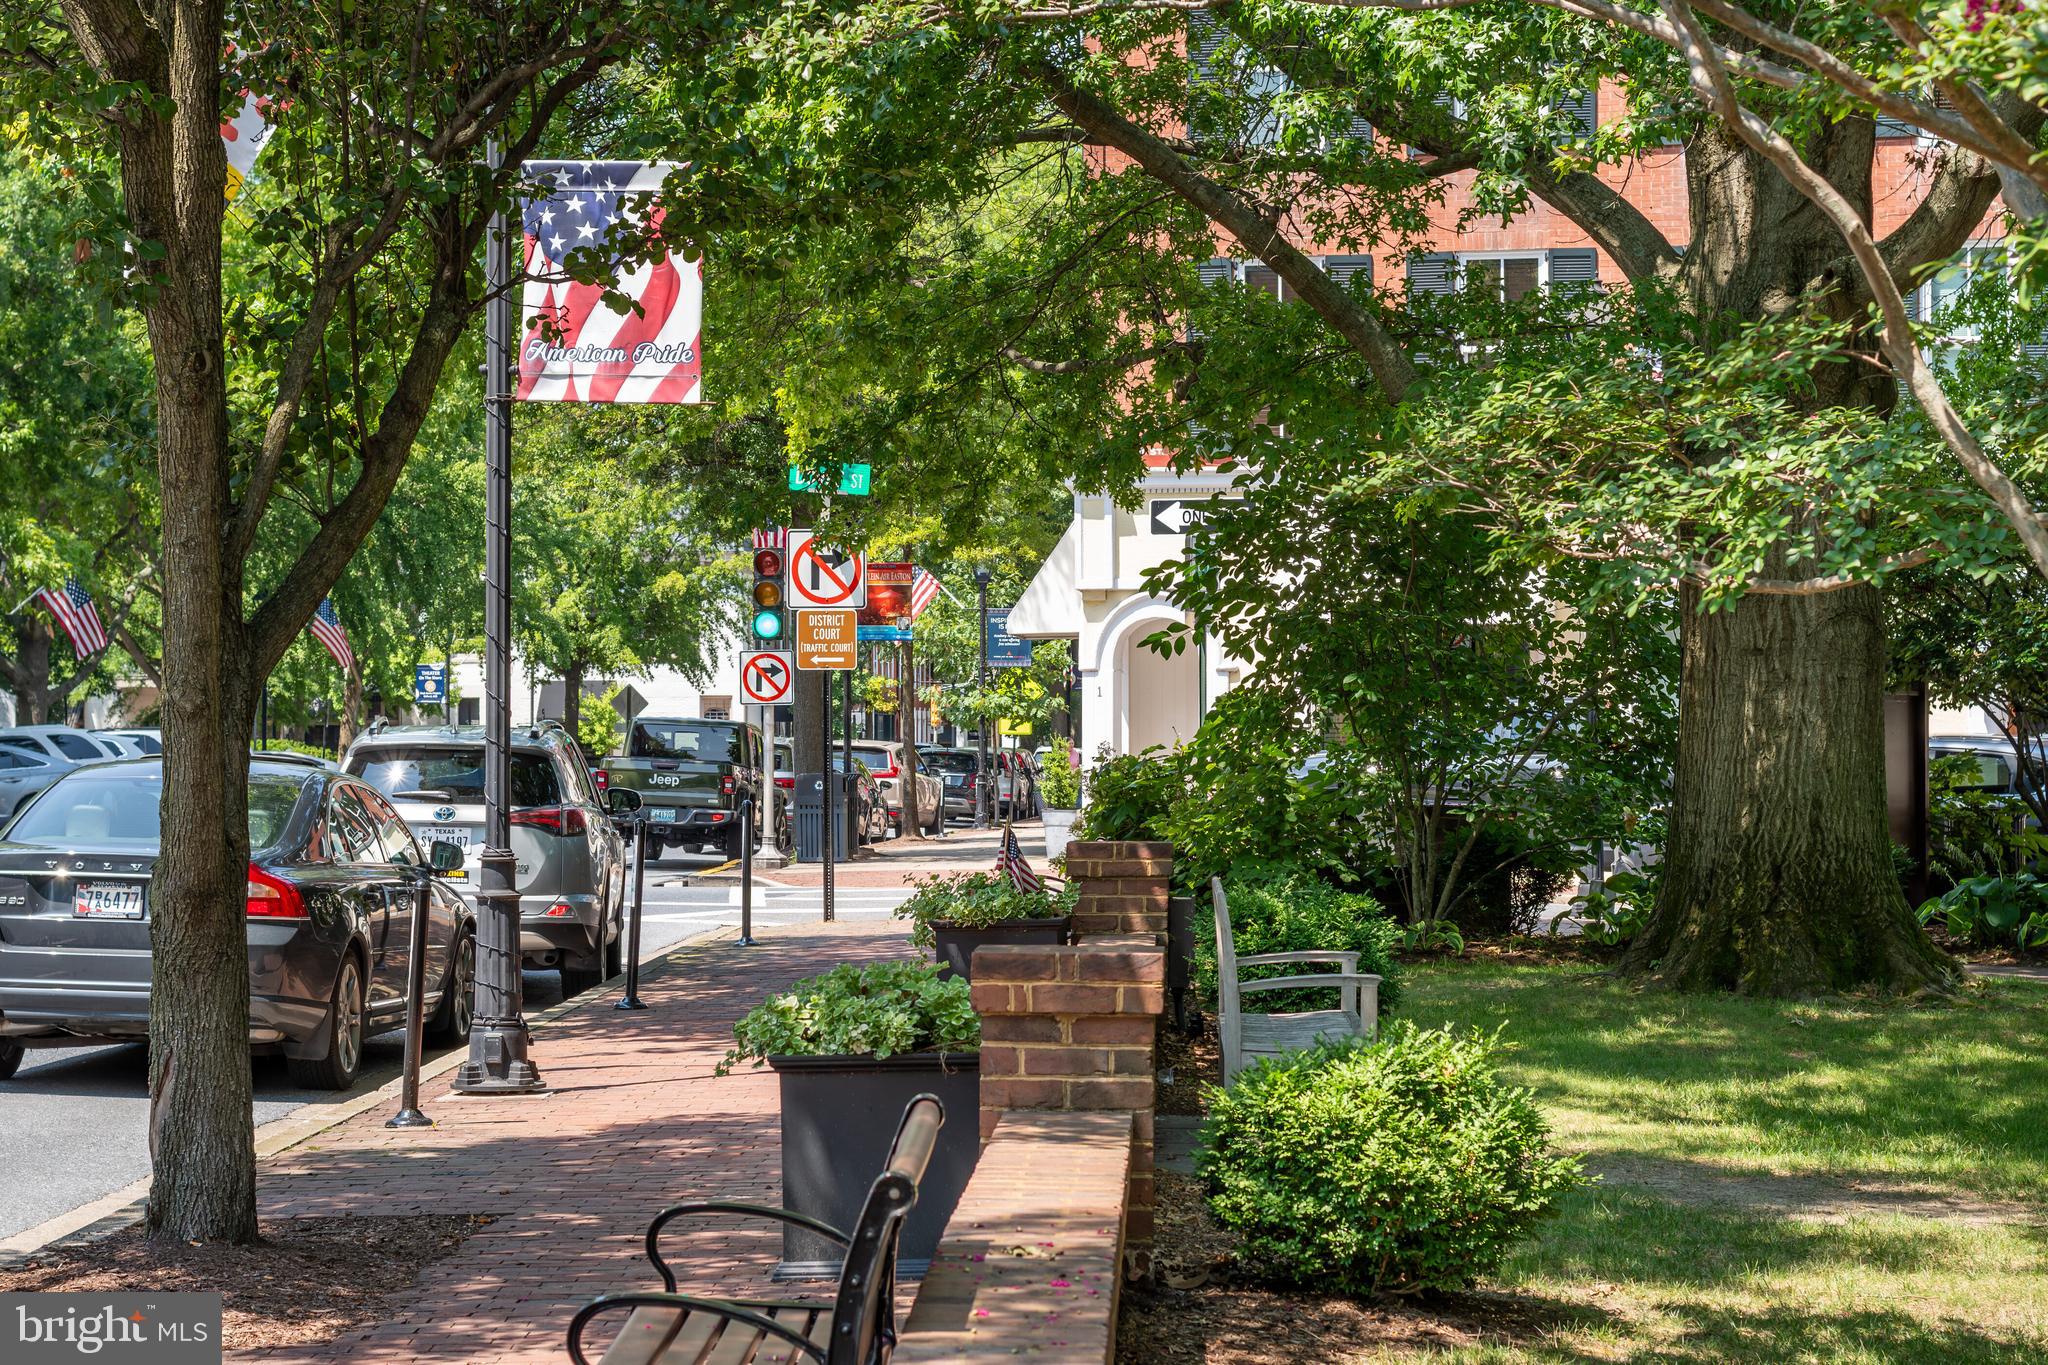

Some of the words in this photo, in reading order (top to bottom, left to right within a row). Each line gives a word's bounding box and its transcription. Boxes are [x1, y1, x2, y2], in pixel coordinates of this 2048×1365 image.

[525, 339, 627, 363] American
[632, 342, 695, 364] Pride
[851, 473, 864, 489] ST
[867, 572, 880, 581] LEIN
[809, 614, 845, 627] DISTRICT
[813, 628, 841, 640] COURT
[800, 641, 828, 654] (TRAFFIC
[830, 641, 854, 654] COURT)
[648, 773, 680, 787] Jeep
[44, 860, 143, 872] VOLV
